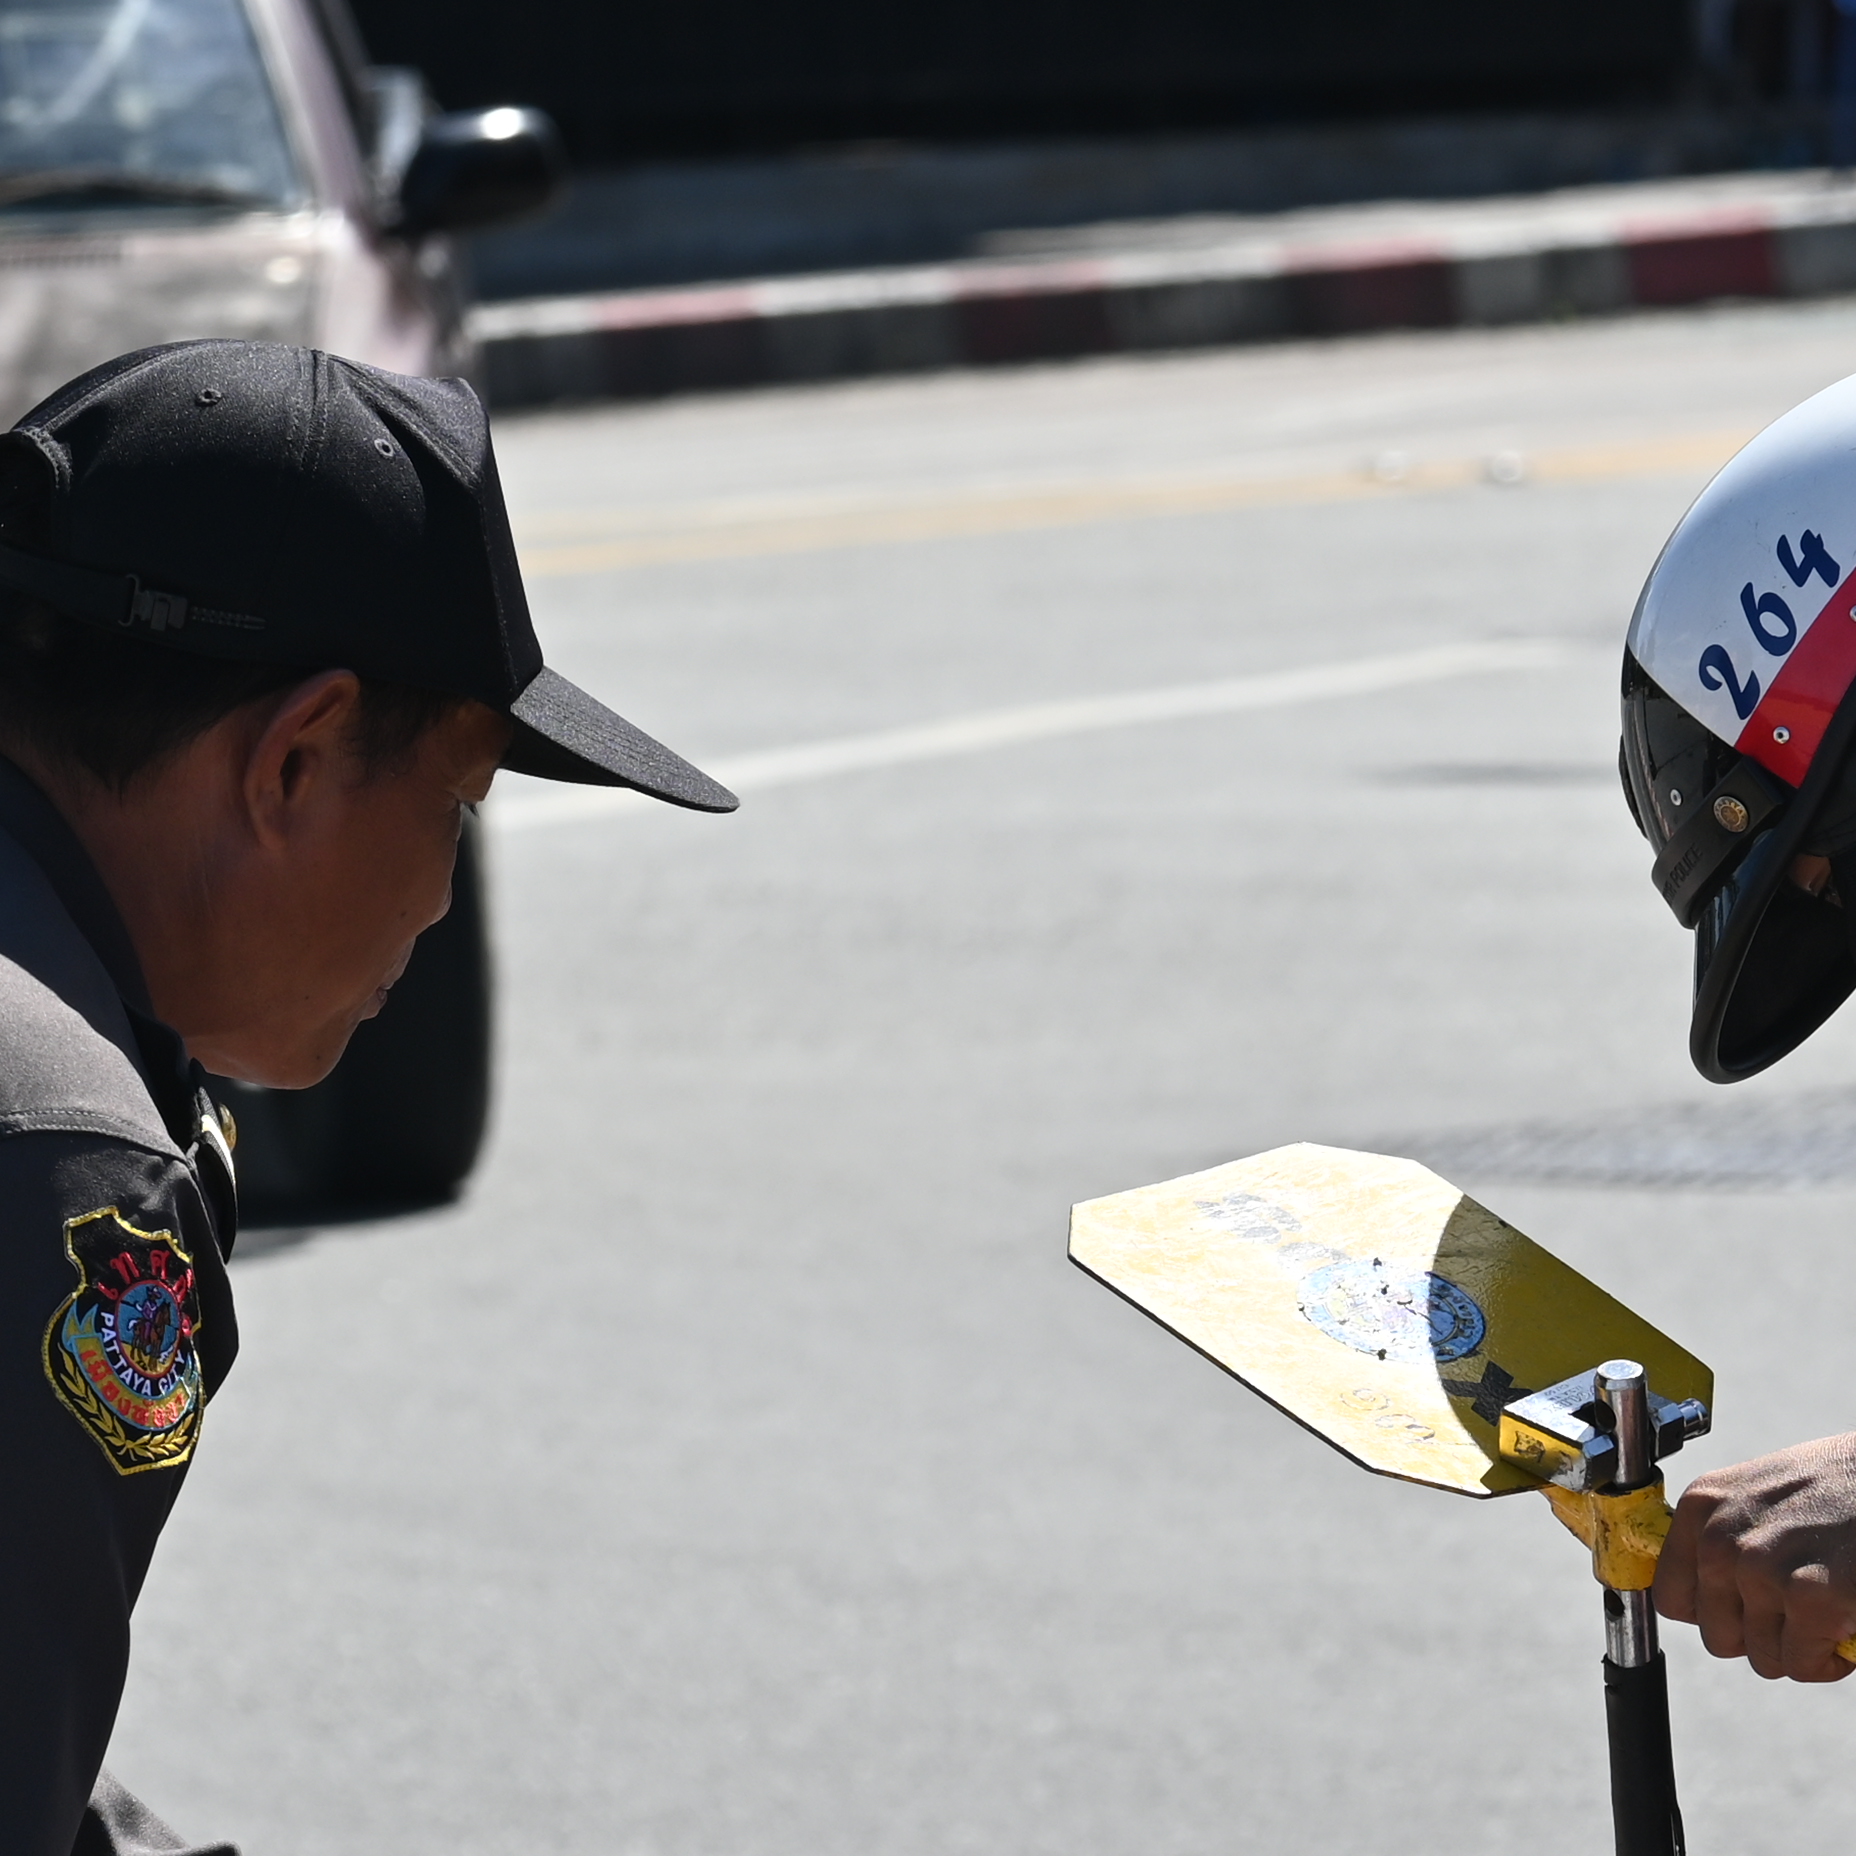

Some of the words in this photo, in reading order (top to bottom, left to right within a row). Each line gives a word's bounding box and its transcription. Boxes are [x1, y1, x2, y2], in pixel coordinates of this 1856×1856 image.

[1698, 528, 1841, 720] 264
[99, 1310, 154, 1397] PATTAYA
[157, 1349, 186, 1396] CITY
